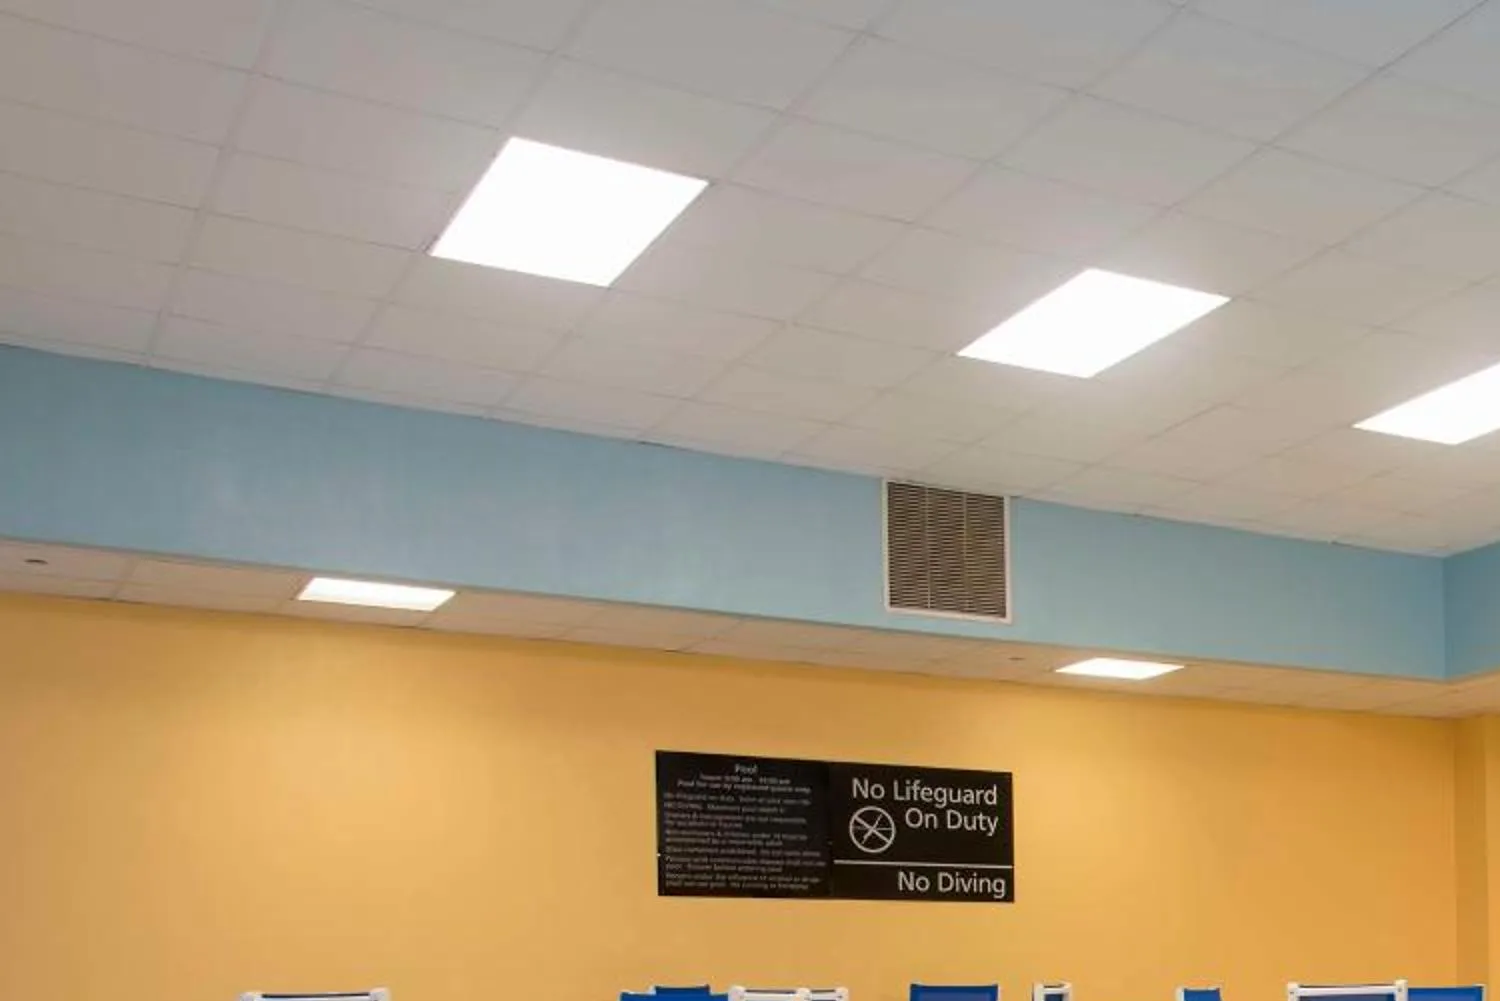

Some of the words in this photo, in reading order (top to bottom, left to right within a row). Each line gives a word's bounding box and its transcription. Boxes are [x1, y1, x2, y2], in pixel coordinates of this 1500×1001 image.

[851, 777, 885, 799] No
[893, 779, 998, 808] Lifeguard
[905, 807, 938, 829] On
[947, 809, 999, 836] Duty
[897, 871, 931, 892] No
[938, 872, 1006, 899] Diving
